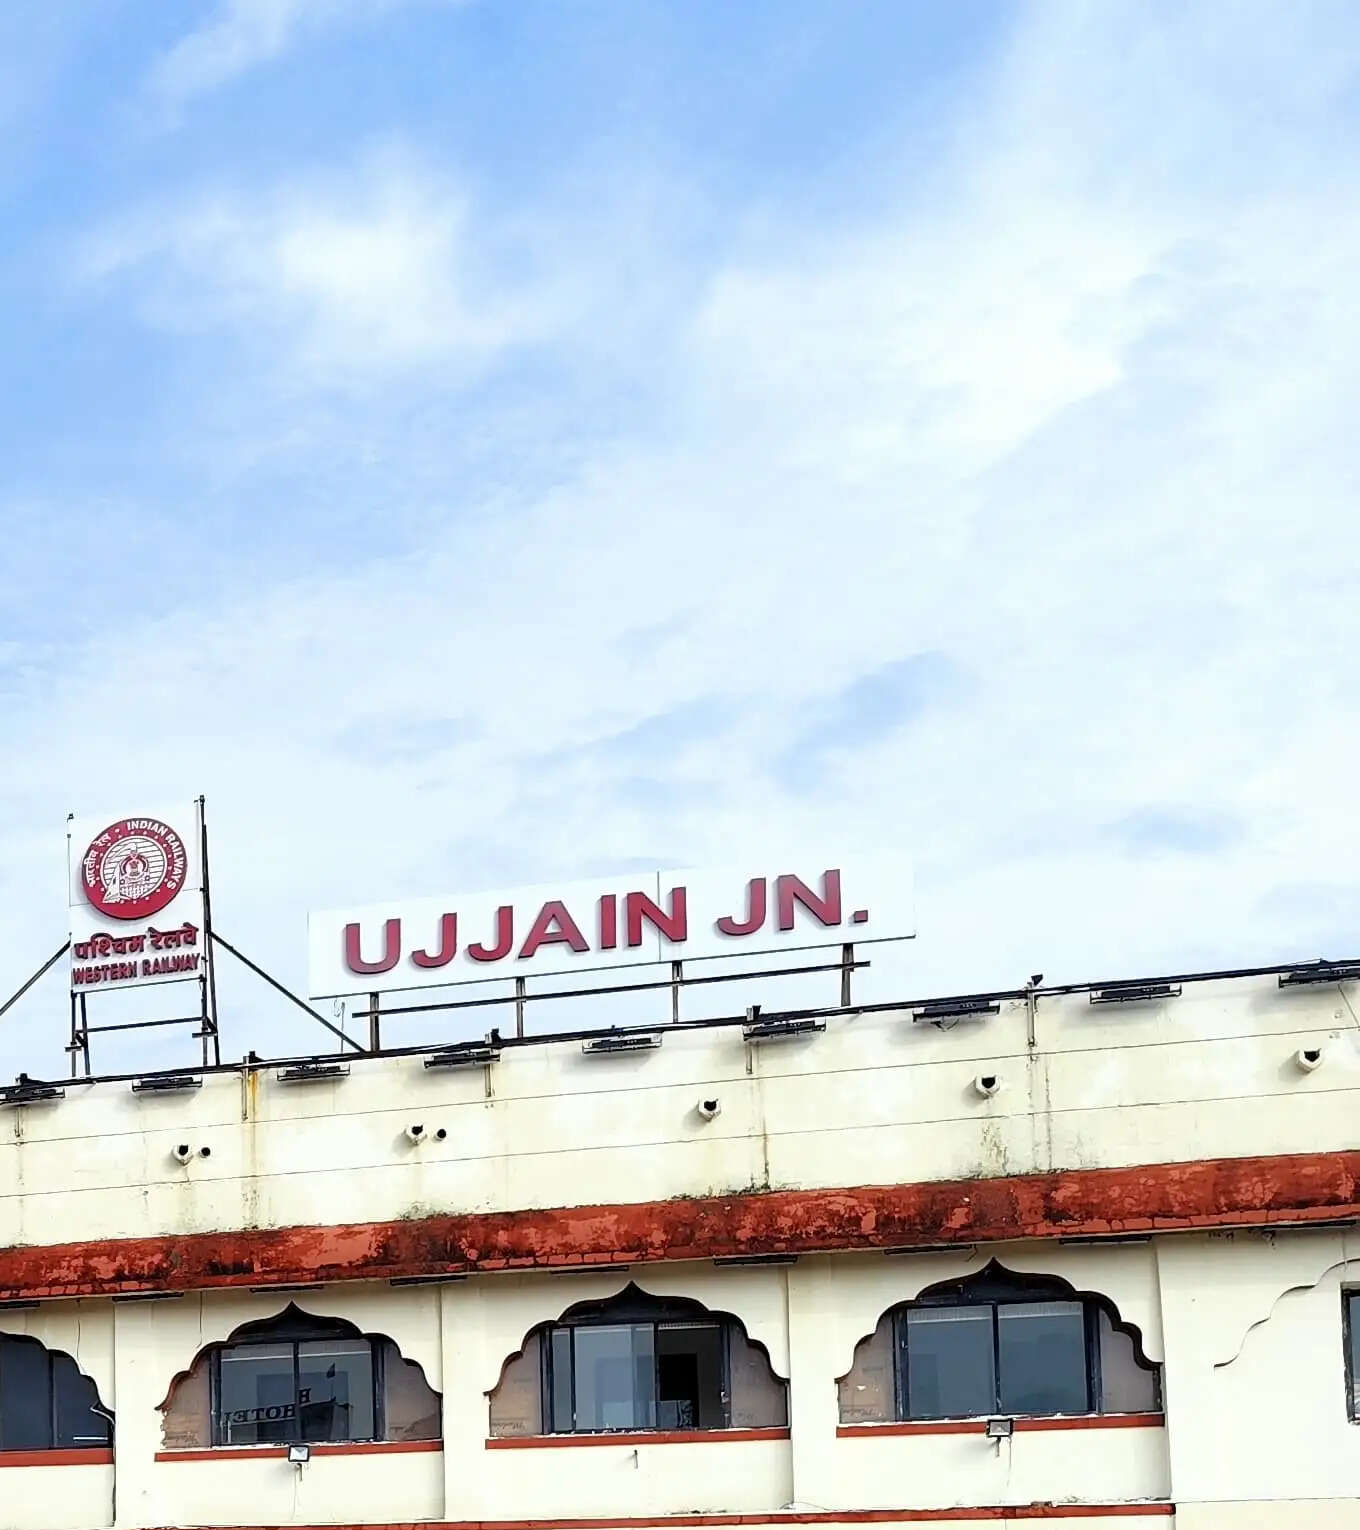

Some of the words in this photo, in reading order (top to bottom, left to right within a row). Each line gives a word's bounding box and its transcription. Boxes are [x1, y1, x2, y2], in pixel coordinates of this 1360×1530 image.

[126, 819, 169, 837] INDIAN
[165, 831, 188, 890] RAILWAYS
[73, 932, 146, 960] पश्चिम
[147, 921, 200, 950] रेलवे
[344, 886, 688, 975] UJJAIN
[716, 868, 869, 937] JN.
[72, 960, 138, 985] WESTERN
[141, 952, 201, 976] RAILWAY
